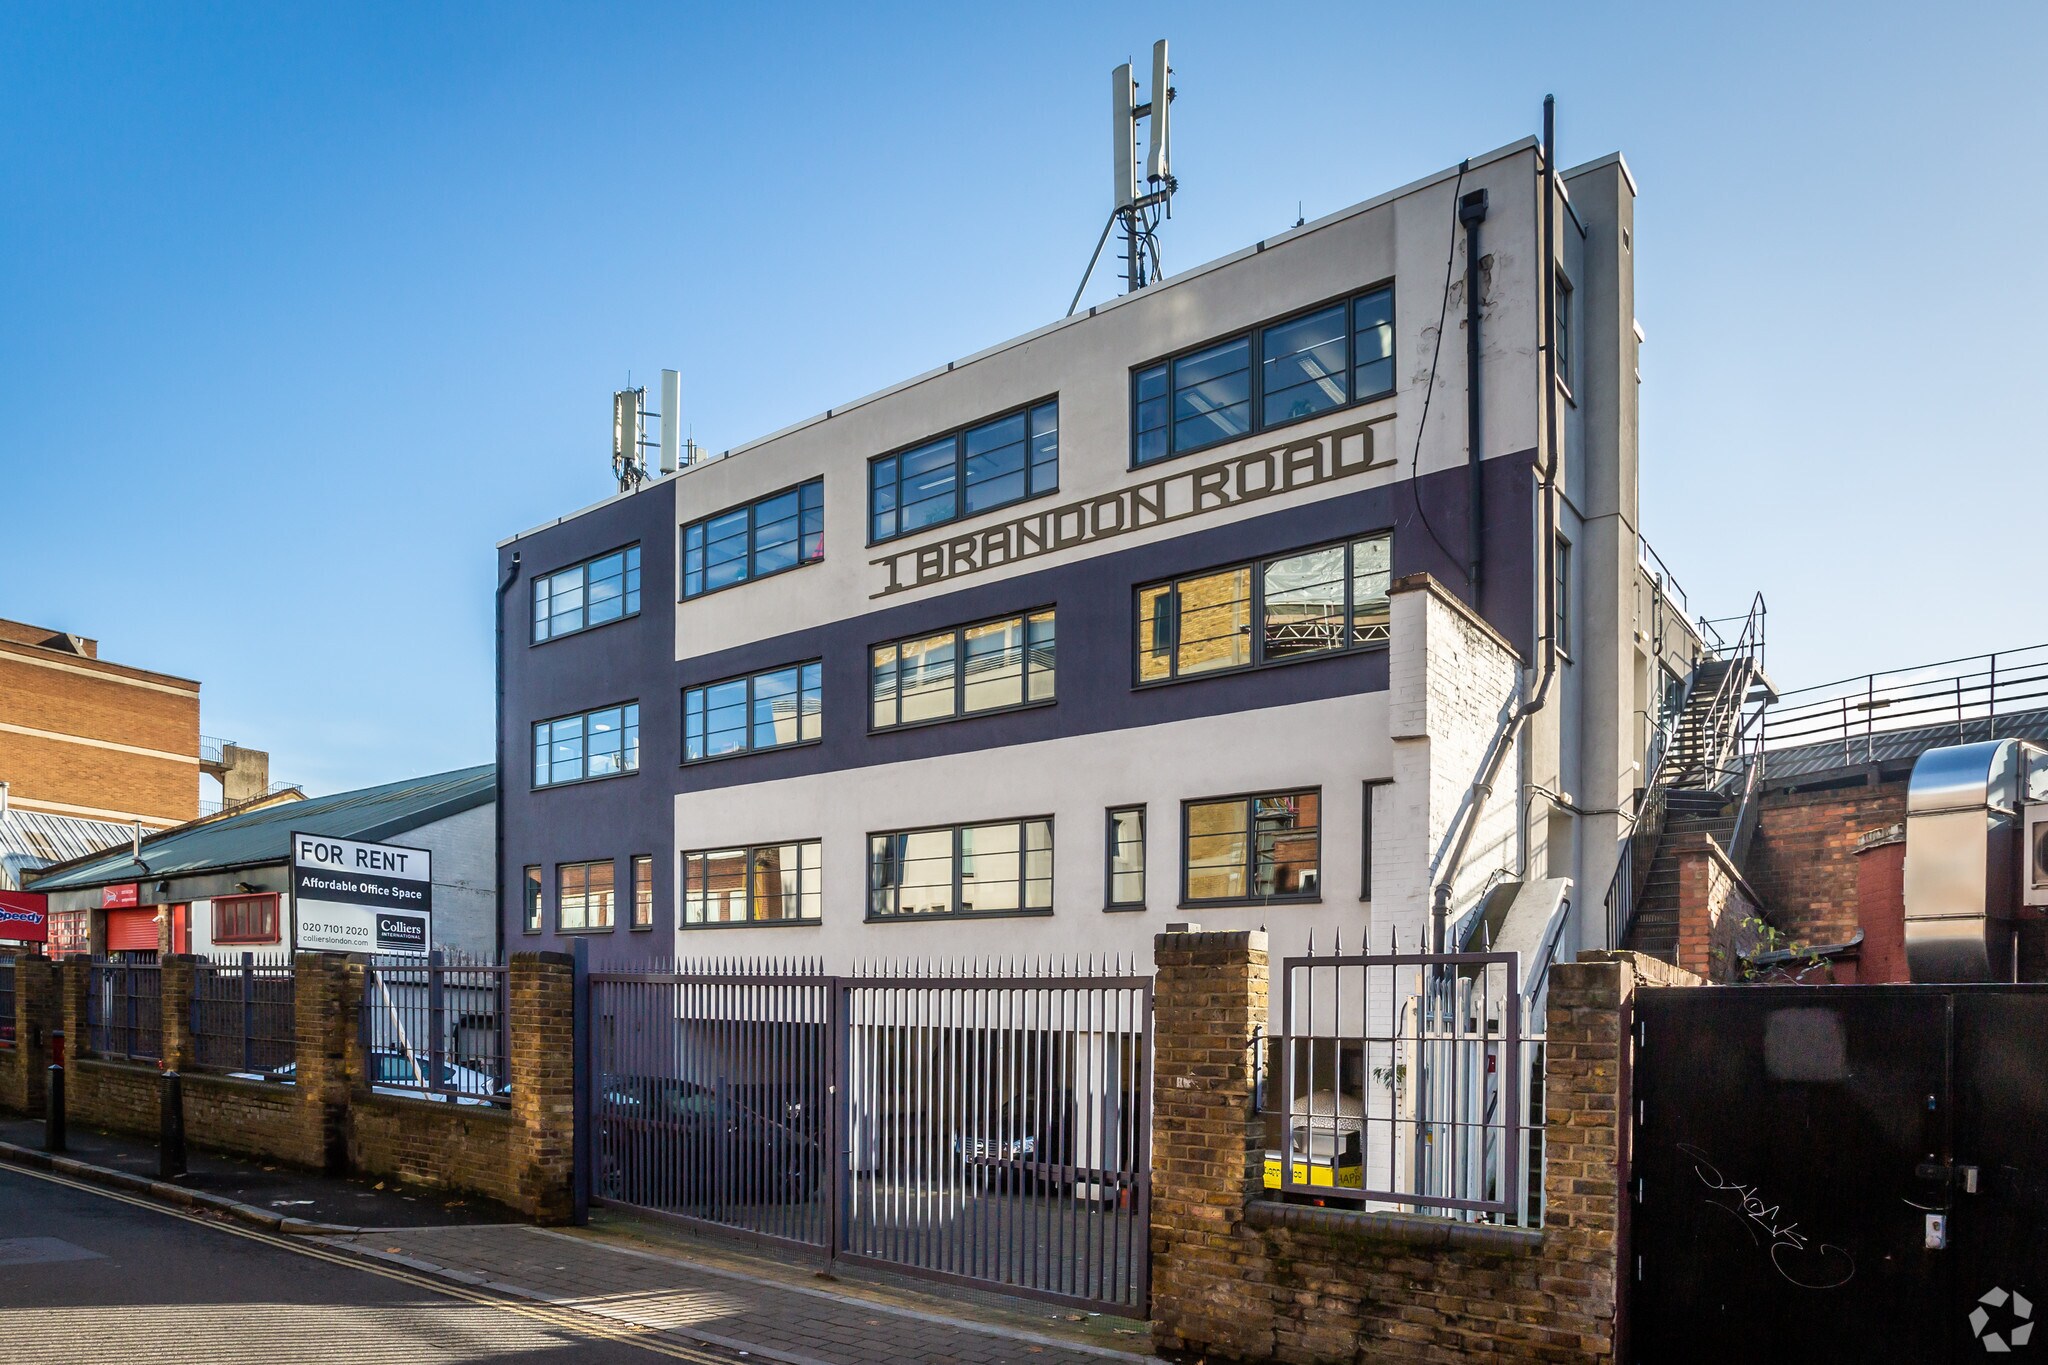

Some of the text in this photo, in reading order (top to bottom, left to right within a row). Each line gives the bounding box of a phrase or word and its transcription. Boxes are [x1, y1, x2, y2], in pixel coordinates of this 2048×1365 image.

[915, 481, 1165, 588] BRANDON
[1192, 424, 1374, 513] ROAD
[301, 841, 409, 873] FOR RENT
[301, 877, 422, 899] Affordable Office Space
[302, 922, 369, 936] 020 7101 2020
[381, 920, 421, 934] Colliers
[303, 935, 369, 946] collierslondon.com
[381, 932, 421, 940] INTERNATIONAL
